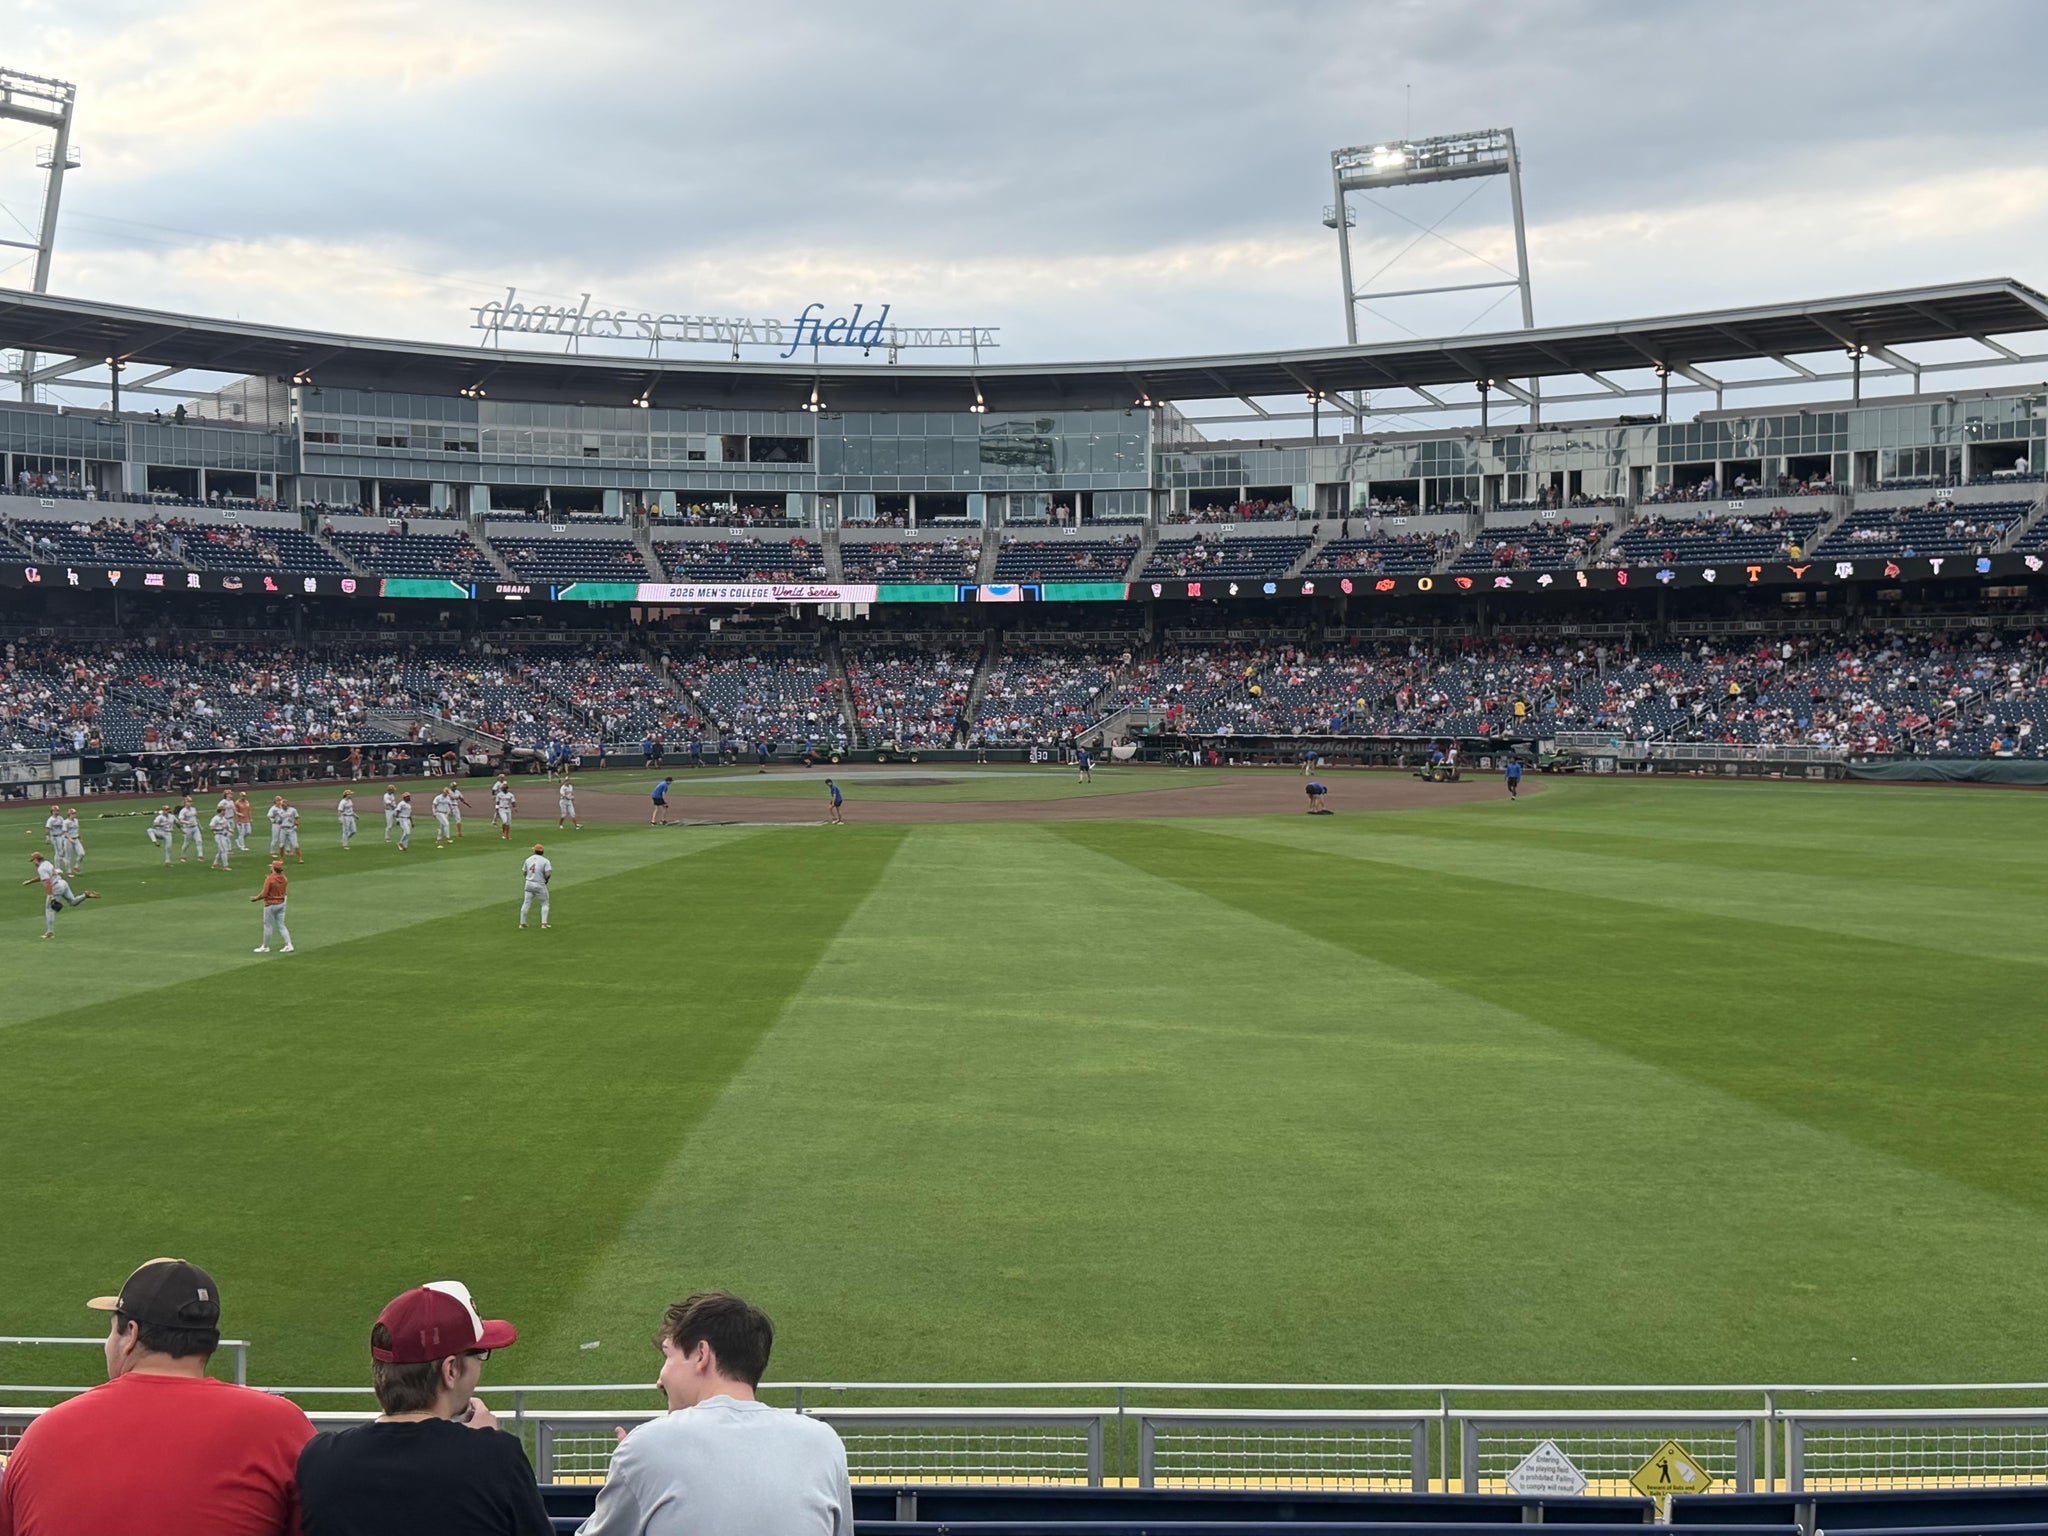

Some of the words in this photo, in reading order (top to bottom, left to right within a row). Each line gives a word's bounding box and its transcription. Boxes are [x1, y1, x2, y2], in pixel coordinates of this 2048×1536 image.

[477, 287, 627, 338] charles
[636, 313, 784, 344] SCHWAB
[780, 303, 890, 359] field
[892, 327, 994, 346] OMAHA
[1746, 566, 1761, 582] T
[496, 584, 530, 594] OMAHA
[1417, 577, 1432, 591] O
[670, 588, 695, 597] 2026
[697, 588, 727, 597] MEN'S
[729, 588, 768, 597] COLLEGE
[772, 586, 804, 597] World
[807, 586, 840, 598] Series
[1188, 583, 1200, 597] N
[529, 863, 537, 874] 4
[1536, 1456, 1559, 1465] Entering
[1536, 1466, 1556, 1474] playing
[1556, 1475, 1575, 1484] Failing
